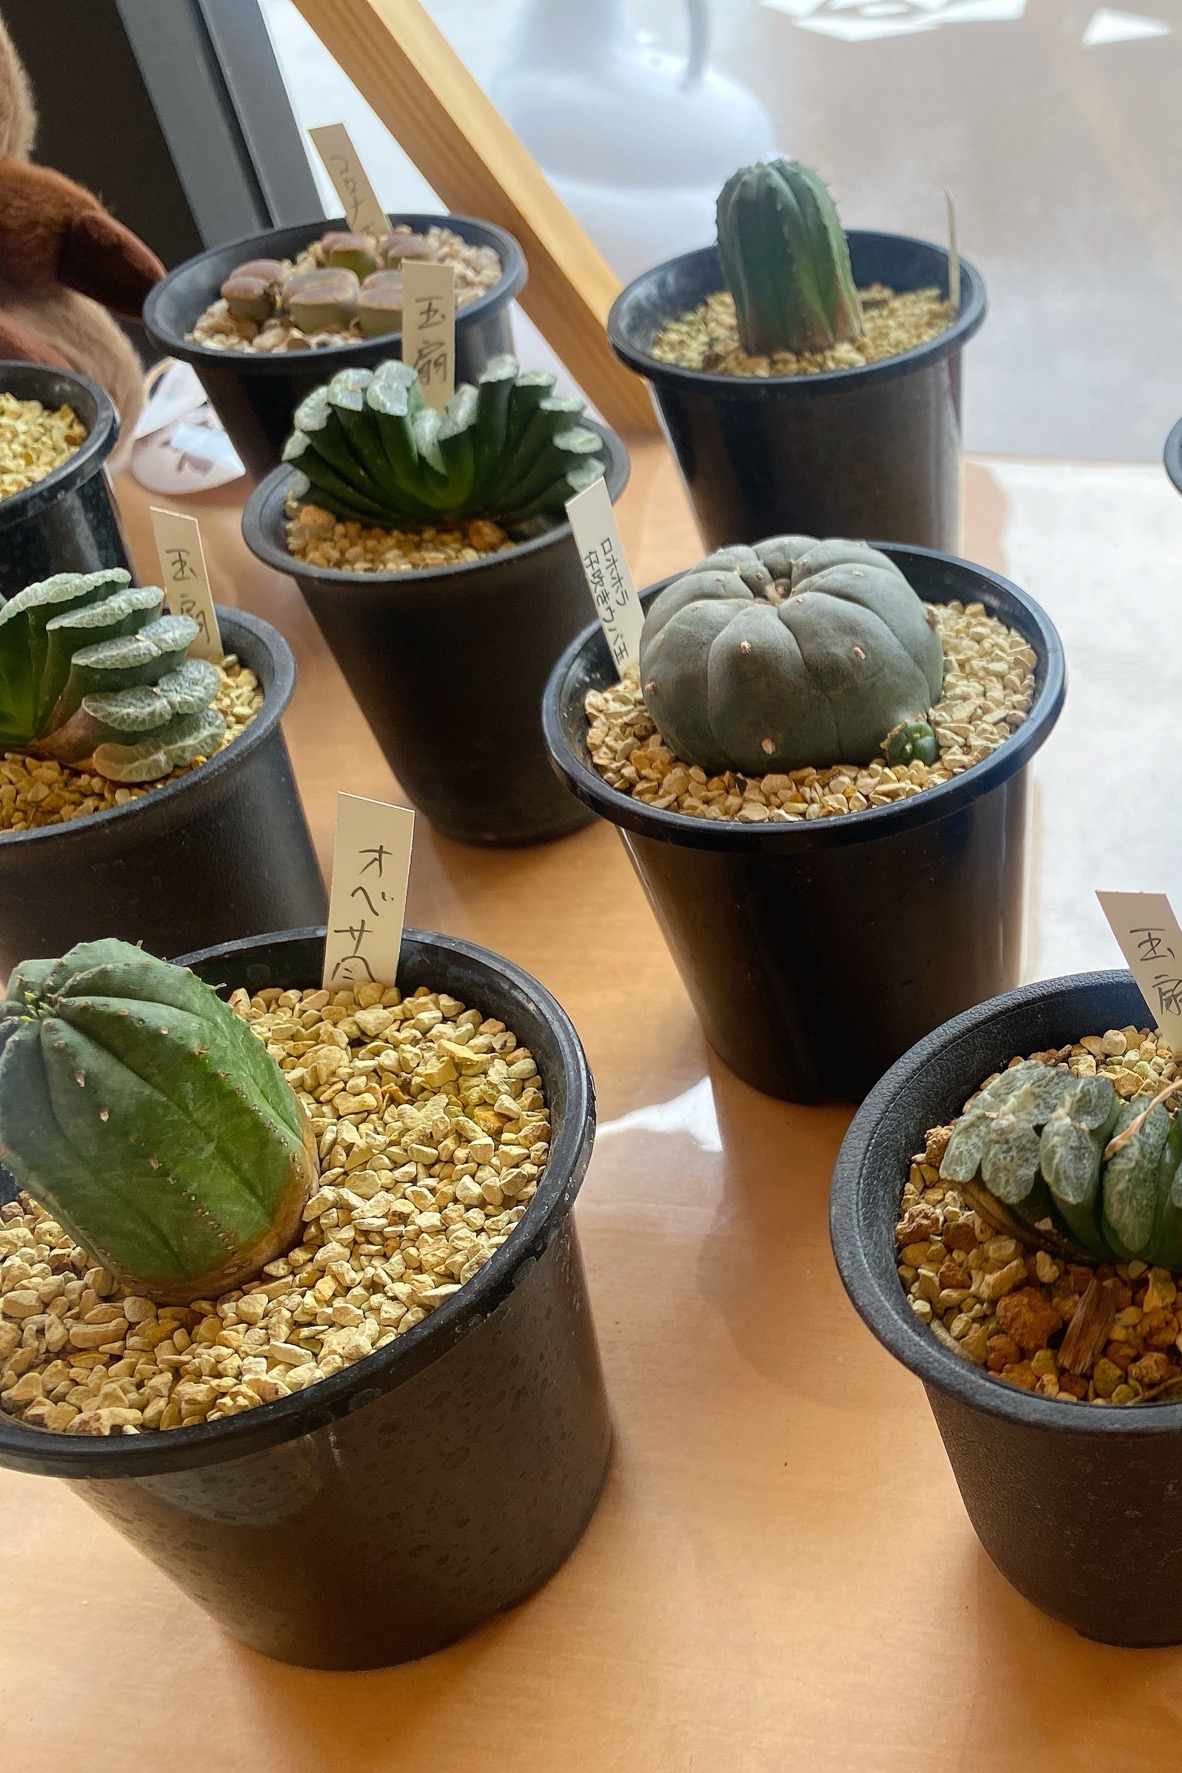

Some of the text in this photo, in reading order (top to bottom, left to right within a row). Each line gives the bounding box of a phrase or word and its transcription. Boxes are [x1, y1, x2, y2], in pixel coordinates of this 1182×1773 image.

[414, 296, 448, 386] 玉扇
[601, 537, 630, 607] ロホホラ
